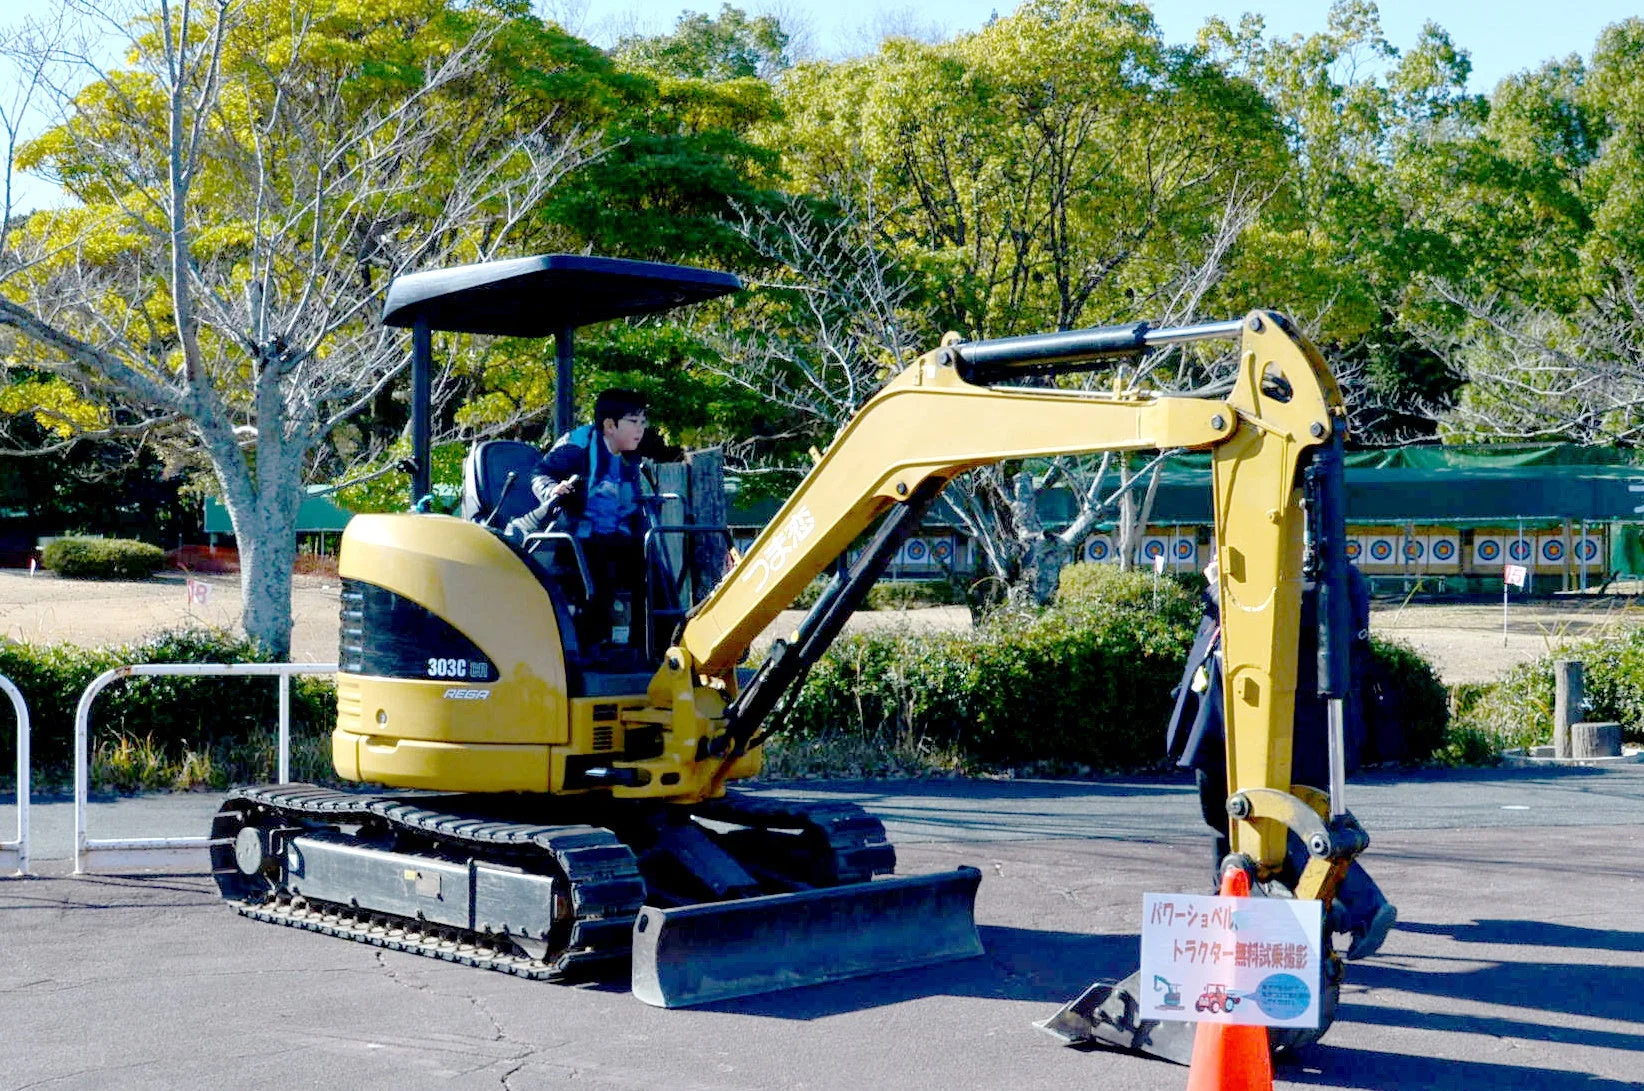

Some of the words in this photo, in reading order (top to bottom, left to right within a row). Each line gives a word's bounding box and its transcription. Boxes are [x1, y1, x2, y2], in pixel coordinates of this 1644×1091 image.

[427, 658, 467, 677] 303C
[443, 689, 490, 700] REGA
[1173, 938, 1308, 969] トラクター無料試乗撮影
